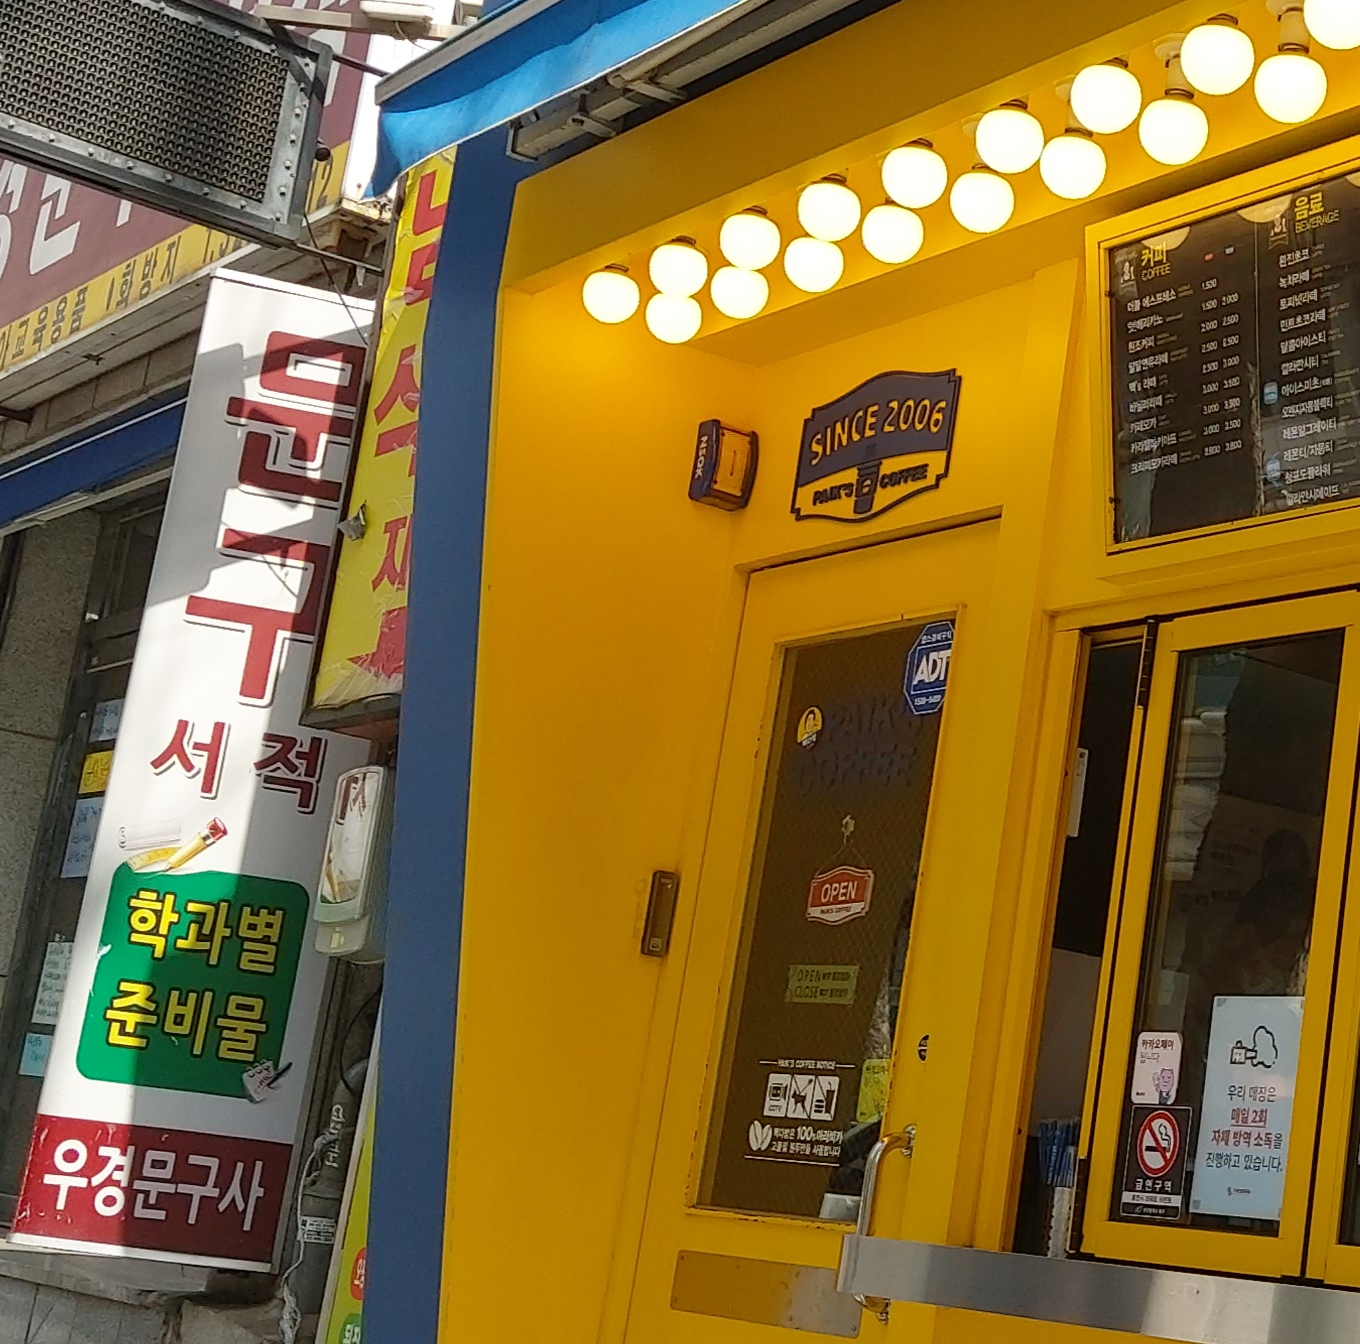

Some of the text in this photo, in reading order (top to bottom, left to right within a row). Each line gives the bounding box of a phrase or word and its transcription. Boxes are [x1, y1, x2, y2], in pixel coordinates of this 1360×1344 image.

[1295, 191, 1324, 221] 음료
[1295, 209, 1340, 233] BEVERAGE
[1141, 241, 1167, 266] 커피
[1141, 263, 1171, 281] COFFEE
[1142, 288, 1176, 307] 에스프레소
[810, 398, 948, 466] SINCE 2006
[812, 463, 930, 507] PAIK'S COFFEE
[182, 330, 367, 707] 문구
[912, 649, 952, 685] ADT
[821, 881, 857, 903] OPEN
[127, 887, 286, 977] 학과별
[103, 980, 270, 1063] 준비물
[1141, 1039, 1175, 1051] 카카오페이
[796, 1059, 816, 1069] COFFEE
[1227, 1085, 1277, 1103] 우리 매장은
[1231, 1108, 1268, 1126] 매일 2회
[1211, 1129, 1283, 1150] 자체 방역 소독을
[1205, 1152, 1283, 1173] 진행하고 있습니다.
[42, 1137, 266, 1233] 우경문구사
[1135, 1178, 1172, 1193] 금연구역
